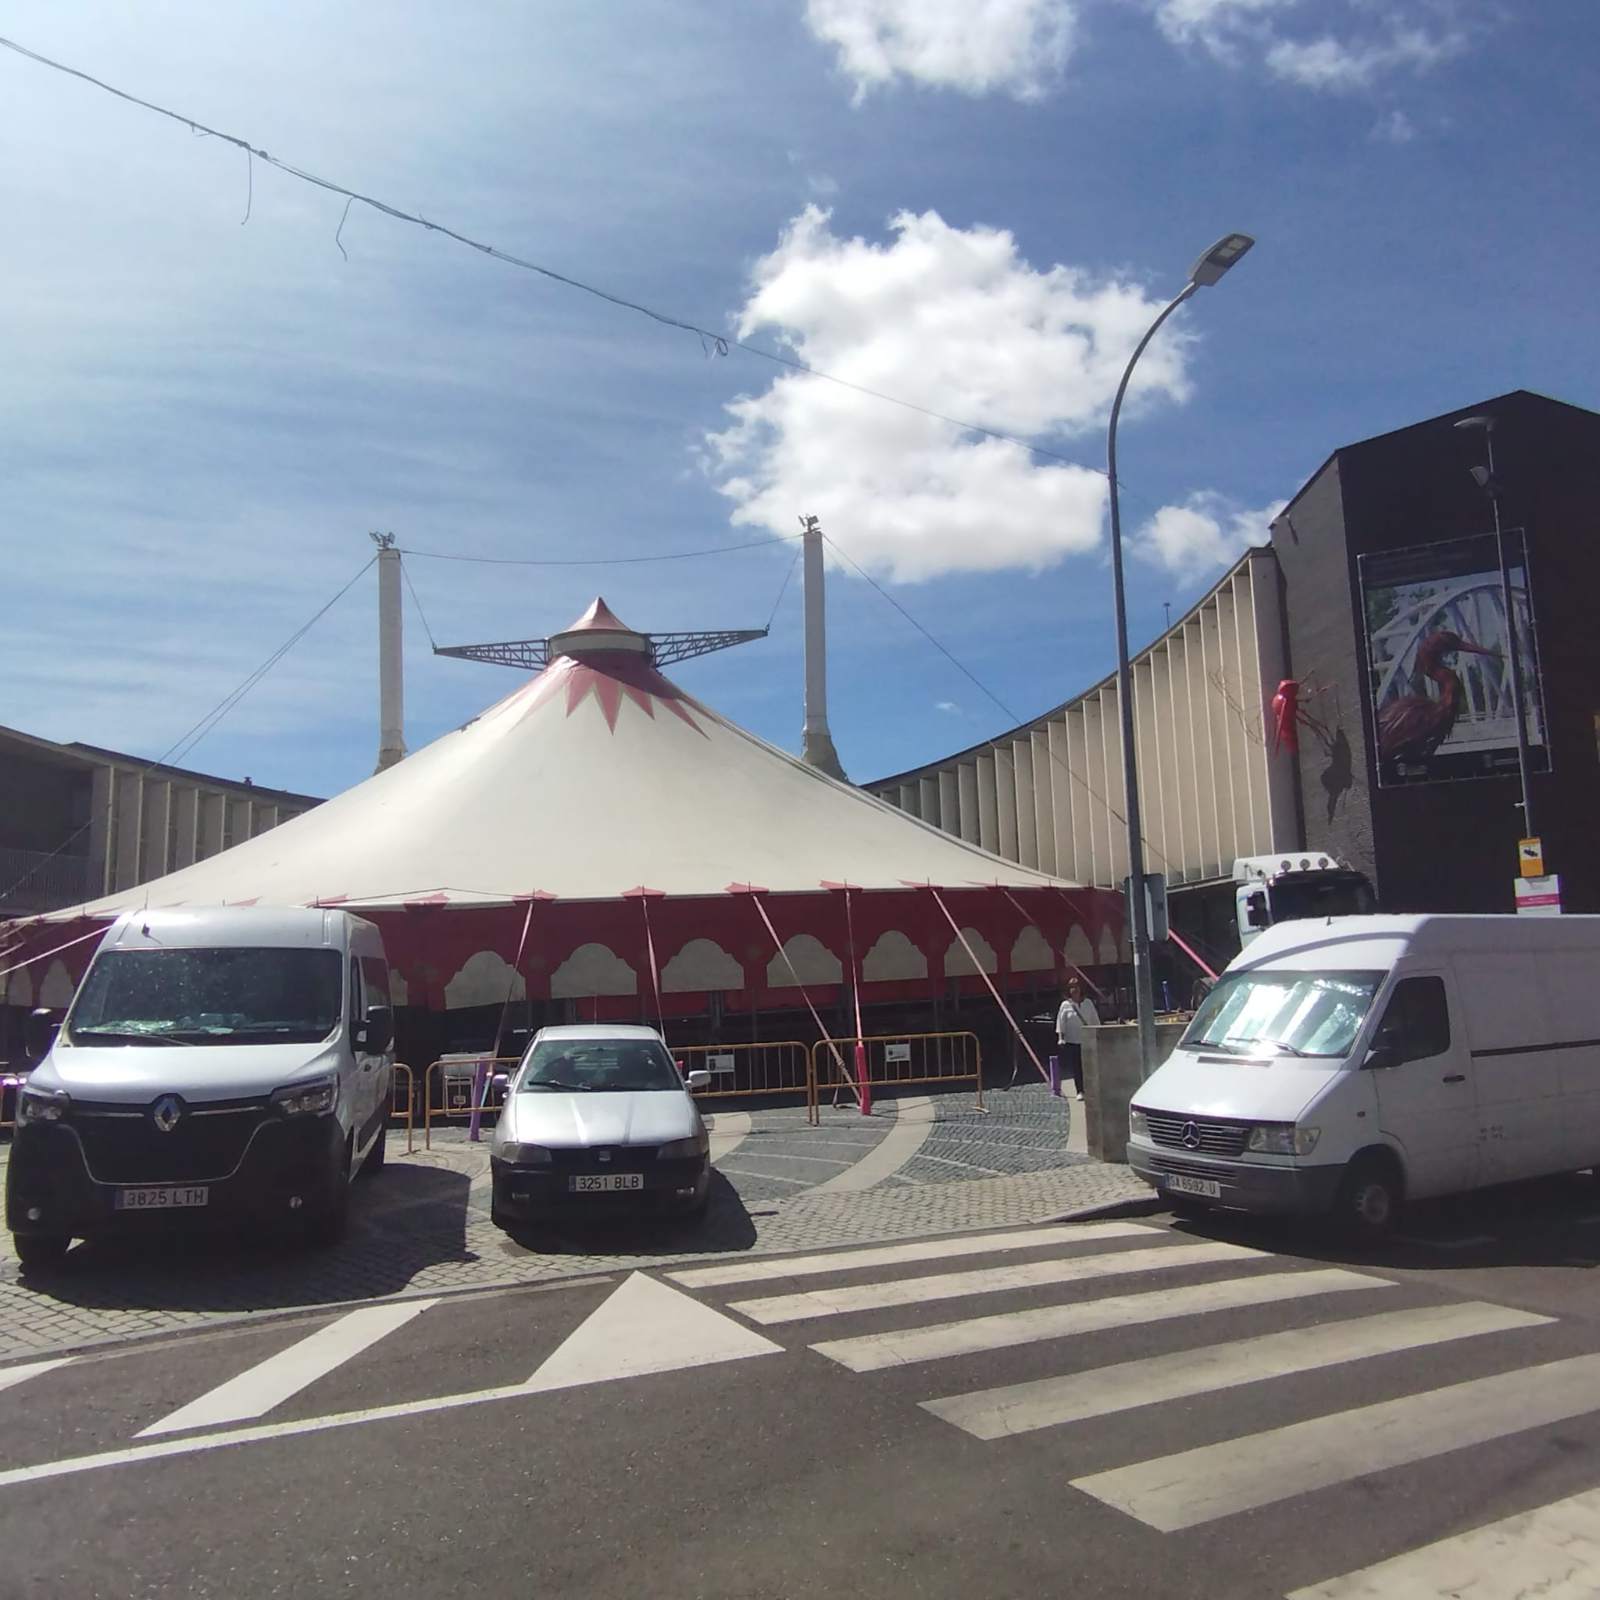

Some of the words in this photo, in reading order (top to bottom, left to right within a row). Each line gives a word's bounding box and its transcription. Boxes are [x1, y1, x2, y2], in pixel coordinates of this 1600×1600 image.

[579, 1177, 608, 1190] 3251
[614, 1175, 639, 1189] BLB
[126, 1190, 168, 1207] 3825
[172, 1188, 204, 1205] LTH
